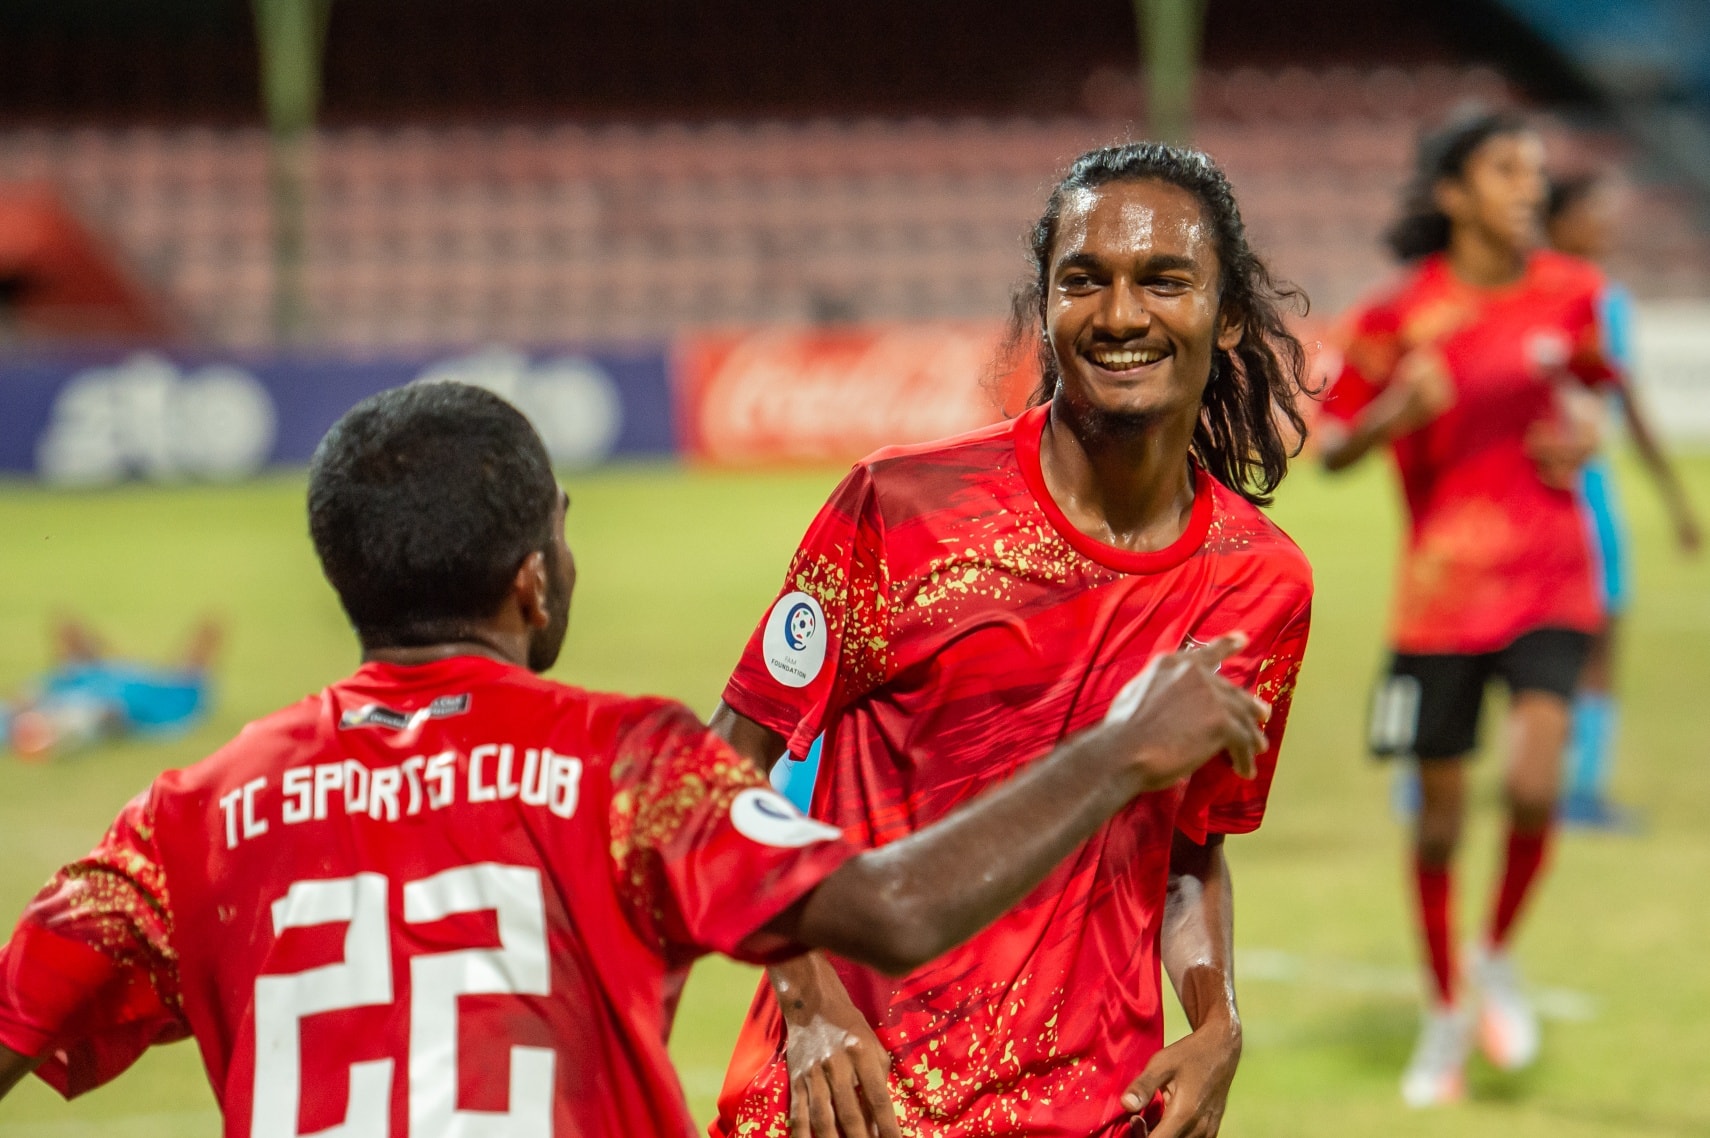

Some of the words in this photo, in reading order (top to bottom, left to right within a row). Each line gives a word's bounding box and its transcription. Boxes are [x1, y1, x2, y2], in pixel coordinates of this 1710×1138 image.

[771, 658, 806, 679] FOUNDATION
[219, 776, 269, 850] TC
[281, 750, 456, 823] SPORTS
[467, 743, 583, 819] CLUB
[250, 861, 556, 1138] 22
